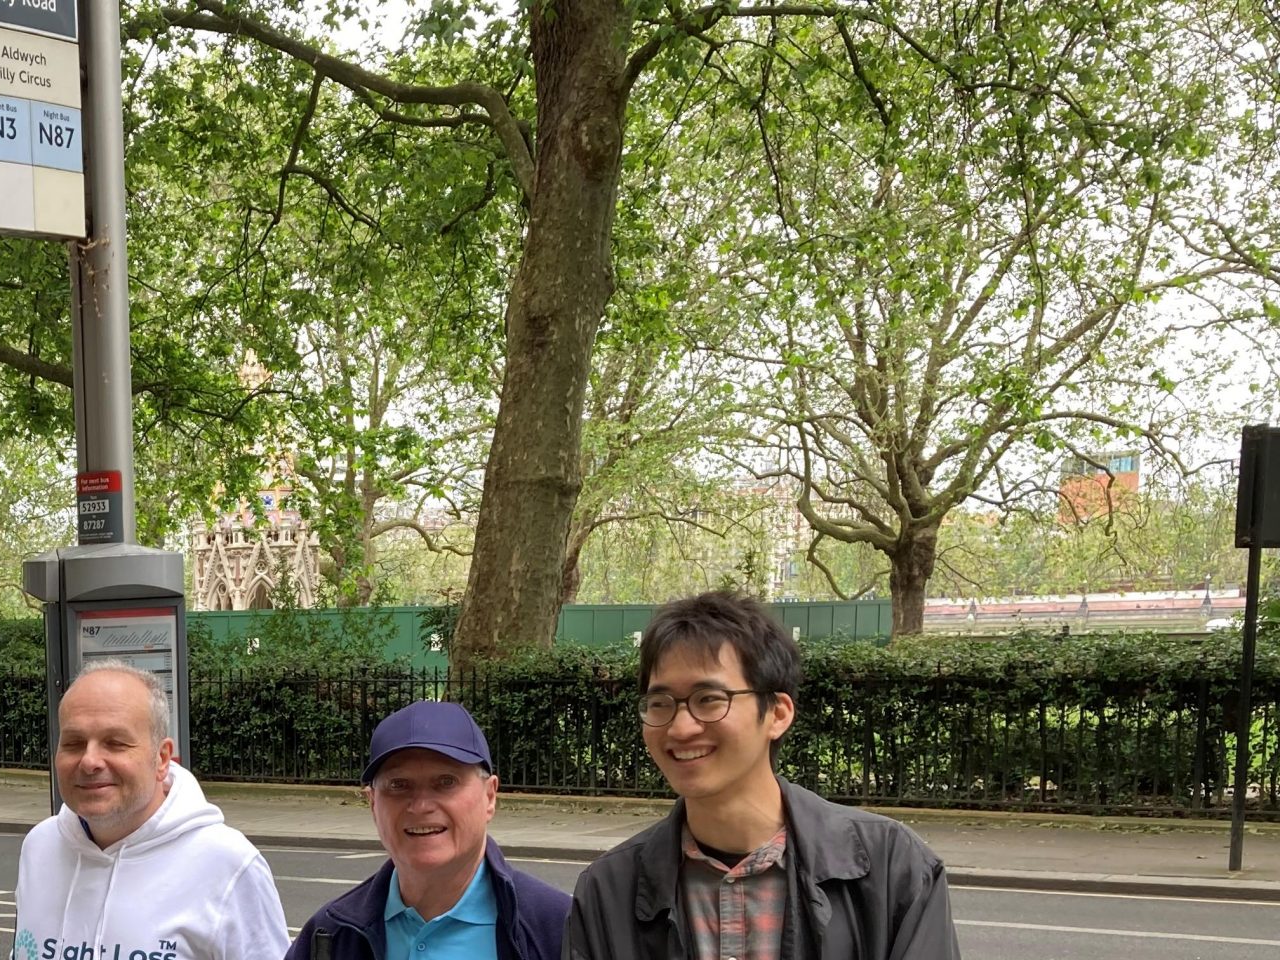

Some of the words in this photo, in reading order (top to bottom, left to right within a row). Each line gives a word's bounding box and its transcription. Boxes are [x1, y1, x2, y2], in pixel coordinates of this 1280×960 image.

[1, 45, 47, 66] Aldwych
[19, 70, 52, 88] Circus
[6, 103, 18, 113] Bus
[43, 109, 59, 121] Night
[59, 113, 70, 122] Bus
[39, 121, 75, 149] N87
[82, 501, 106, 513] 52933
[83, 519, 105, 530] 87287
[82, 626, 101, 636] N87
